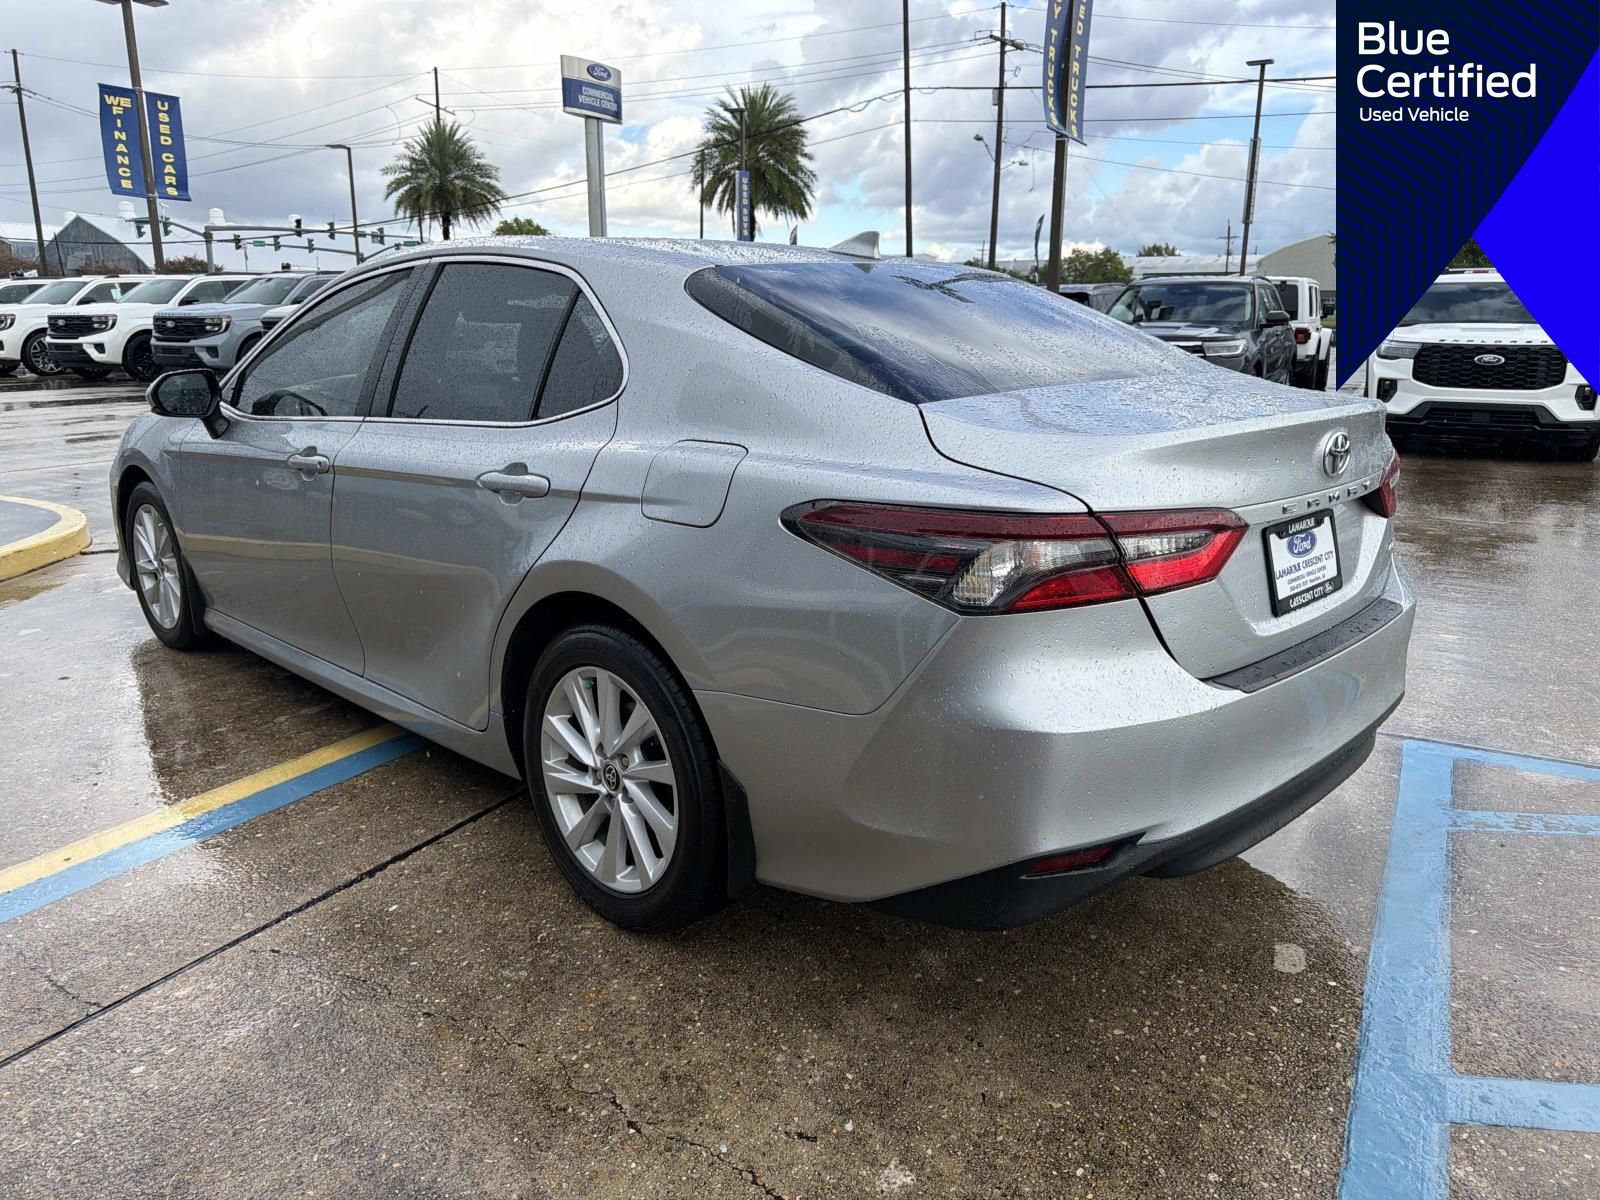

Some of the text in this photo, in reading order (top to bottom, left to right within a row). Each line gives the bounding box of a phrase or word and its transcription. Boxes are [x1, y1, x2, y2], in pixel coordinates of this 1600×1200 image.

[1047, 0, 1062, 126] Y TRUCKS
[1070, 0, 1087, 138] ED TRUCKS
[104, 94, 132, 108] WE
[578, 95, 600, 107] VEHICLE
[582, 86, 614, 102] COMMERCIAL
[112, 106, 133, 189] FINANCE
[157, 100, 178, 196] USED CARS
[1288, 517, 1315, 533] LAMARQUE
[1276, 550, 1334, 579] LAMARQUE CRESCENT CITY
[1290, 591, 1314, 608] CRESCENT
[1313, 586, 1324, 598] CITY
